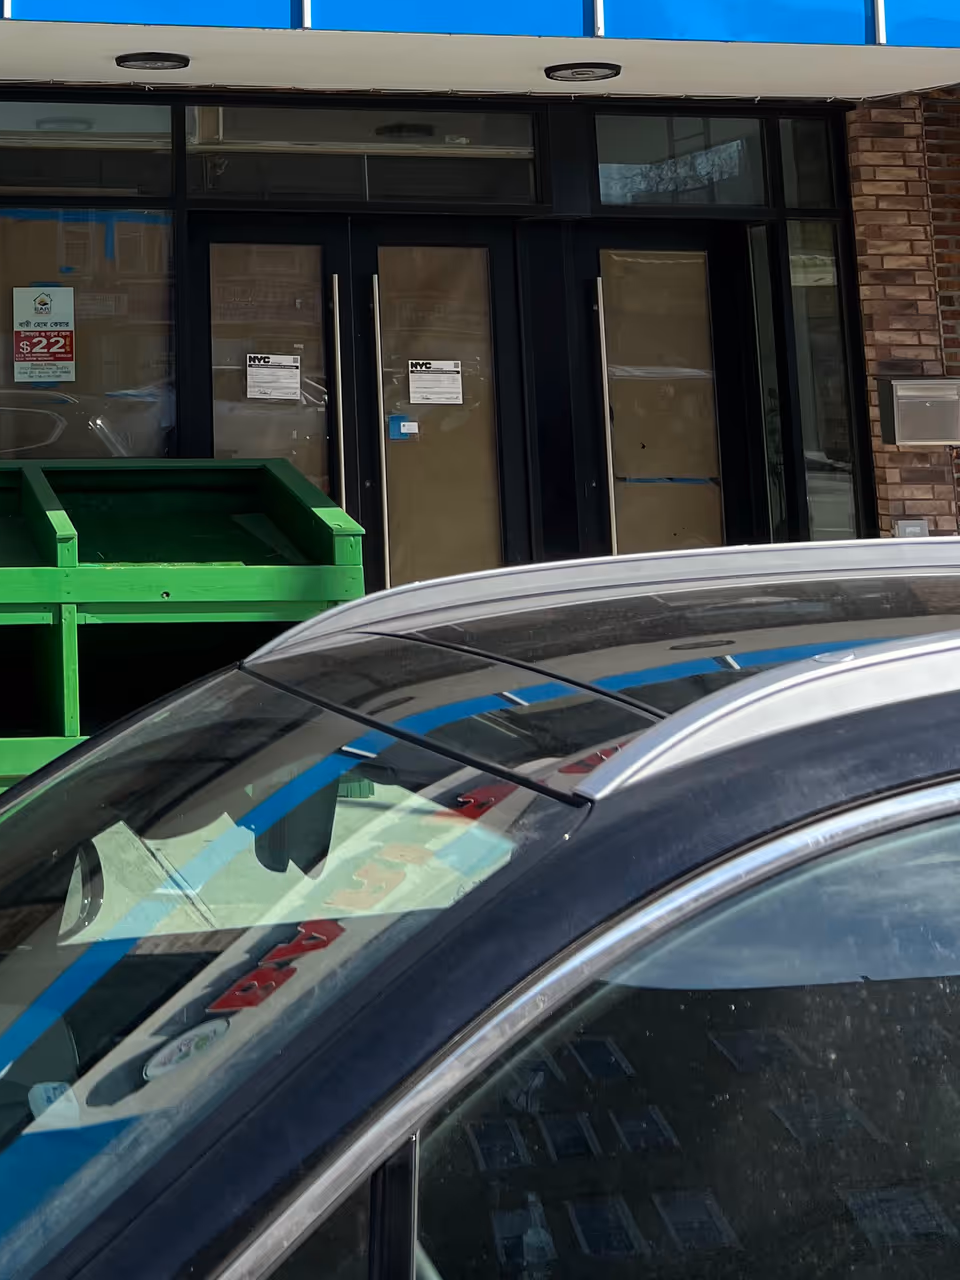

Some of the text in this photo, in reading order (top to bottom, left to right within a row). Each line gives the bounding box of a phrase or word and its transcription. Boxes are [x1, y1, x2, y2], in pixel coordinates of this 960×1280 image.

[20, 337, 65, 353] $22
[248, 355, 271, 364] NYC
[410, 361, 432, 369] NYC
